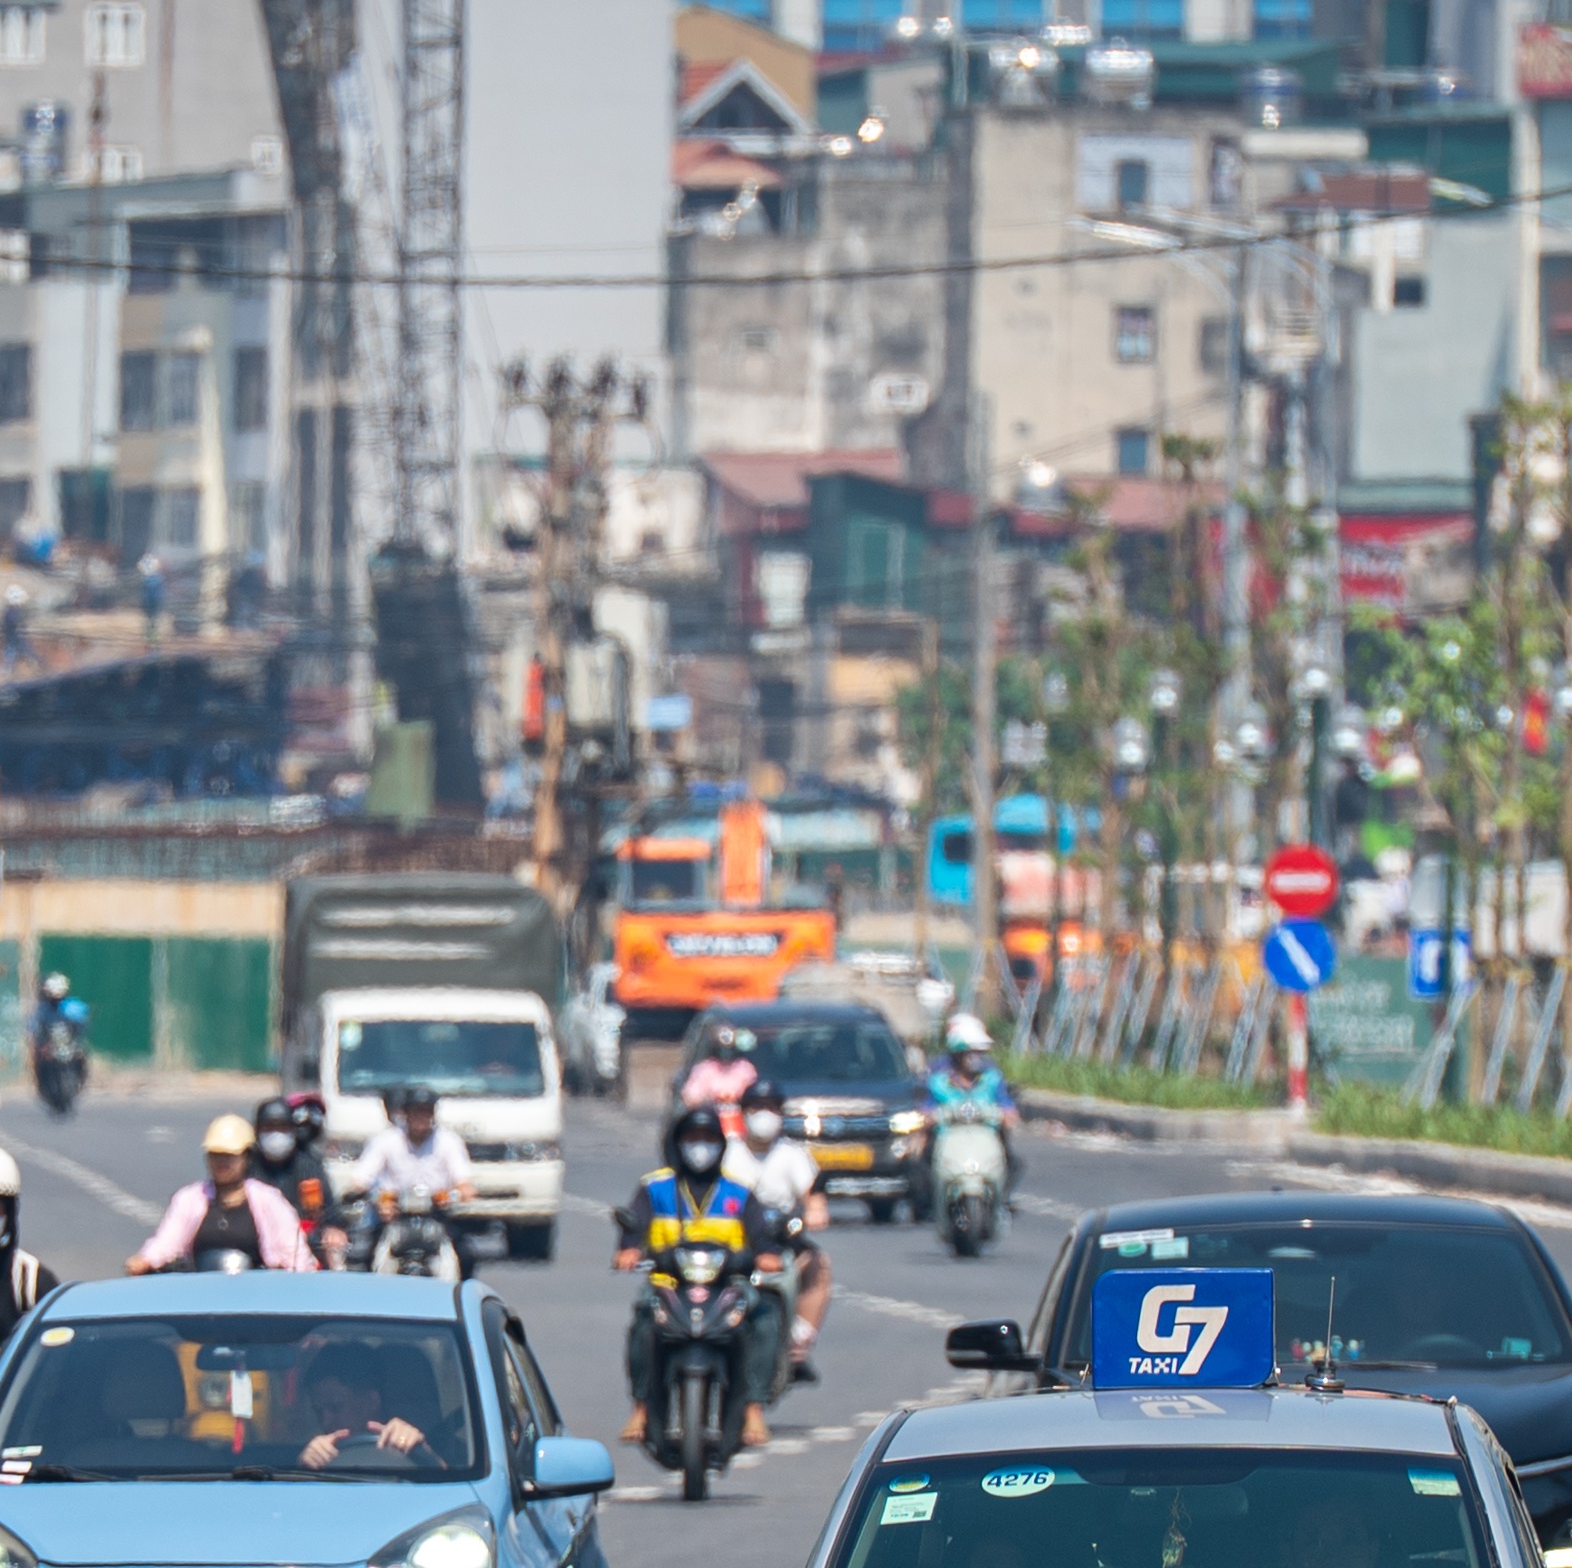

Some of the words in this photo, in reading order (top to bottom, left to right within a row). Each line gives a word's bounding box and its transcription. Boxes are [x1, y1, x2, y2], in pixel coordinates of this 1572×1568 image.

[1136, 1284, 1229, 1375] G7
[1128, 1357, 1178, 1374] TAXI
[986, 1471, 1050, 1488] 4276
